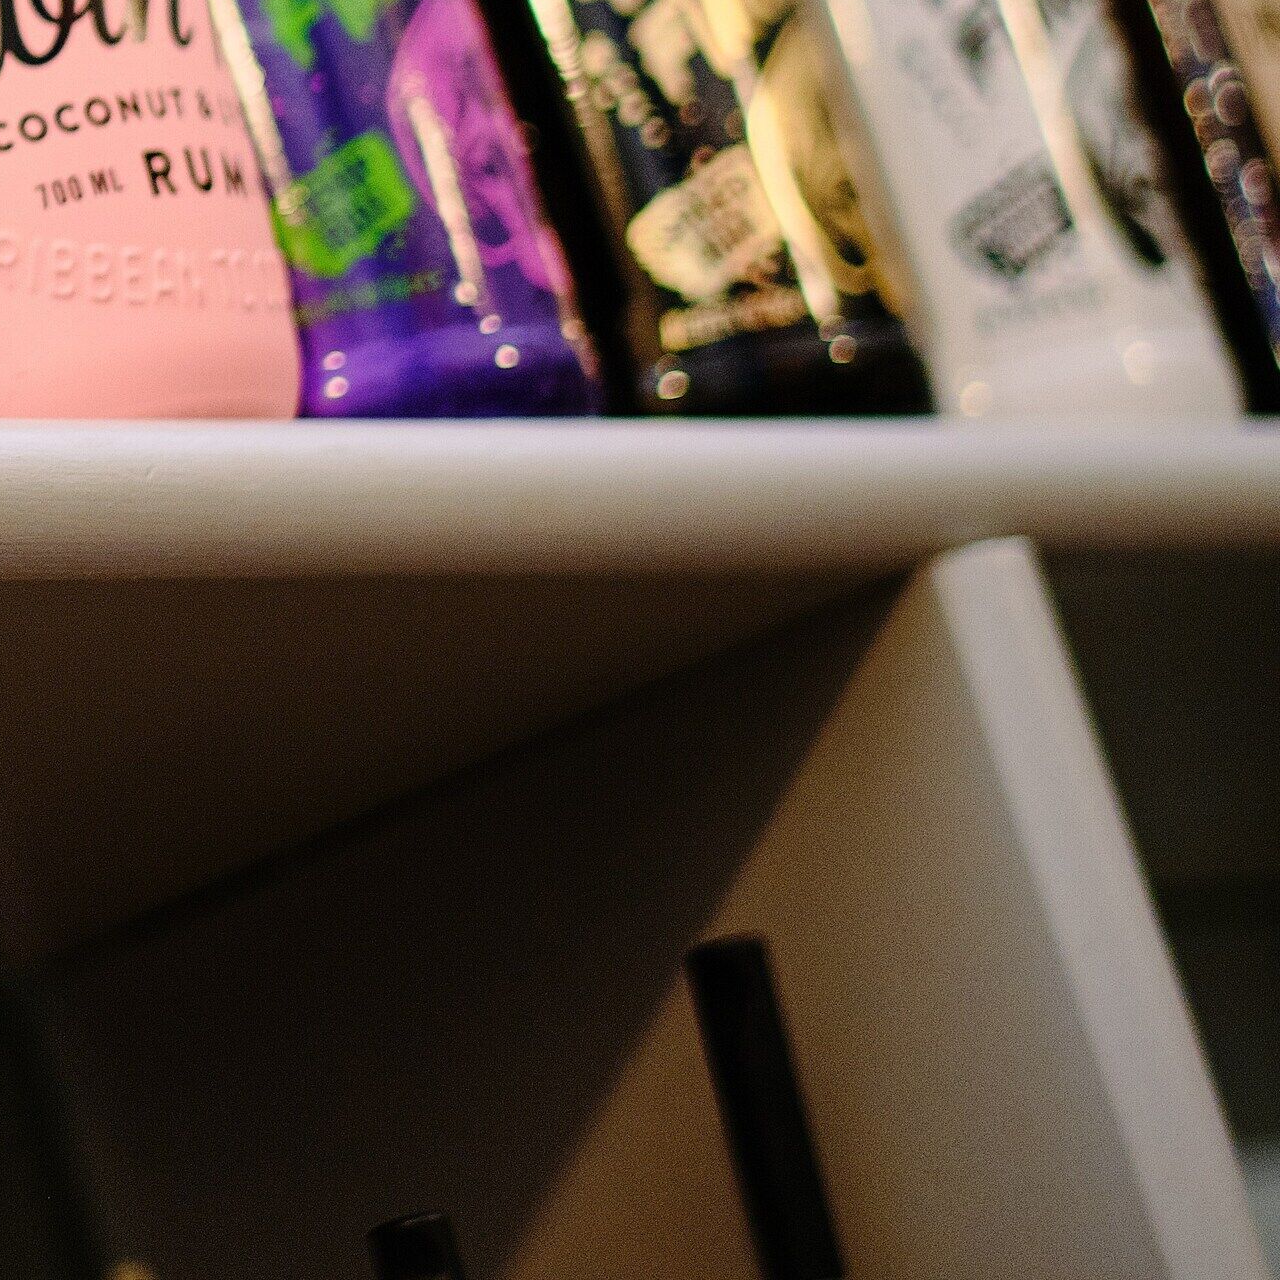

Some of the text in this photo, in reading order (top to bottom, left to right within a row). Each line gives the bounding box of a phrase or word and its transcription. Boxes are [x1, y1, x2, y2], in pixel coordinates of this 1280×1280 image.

[35, 147, 248, 210] 700 ML RUM
